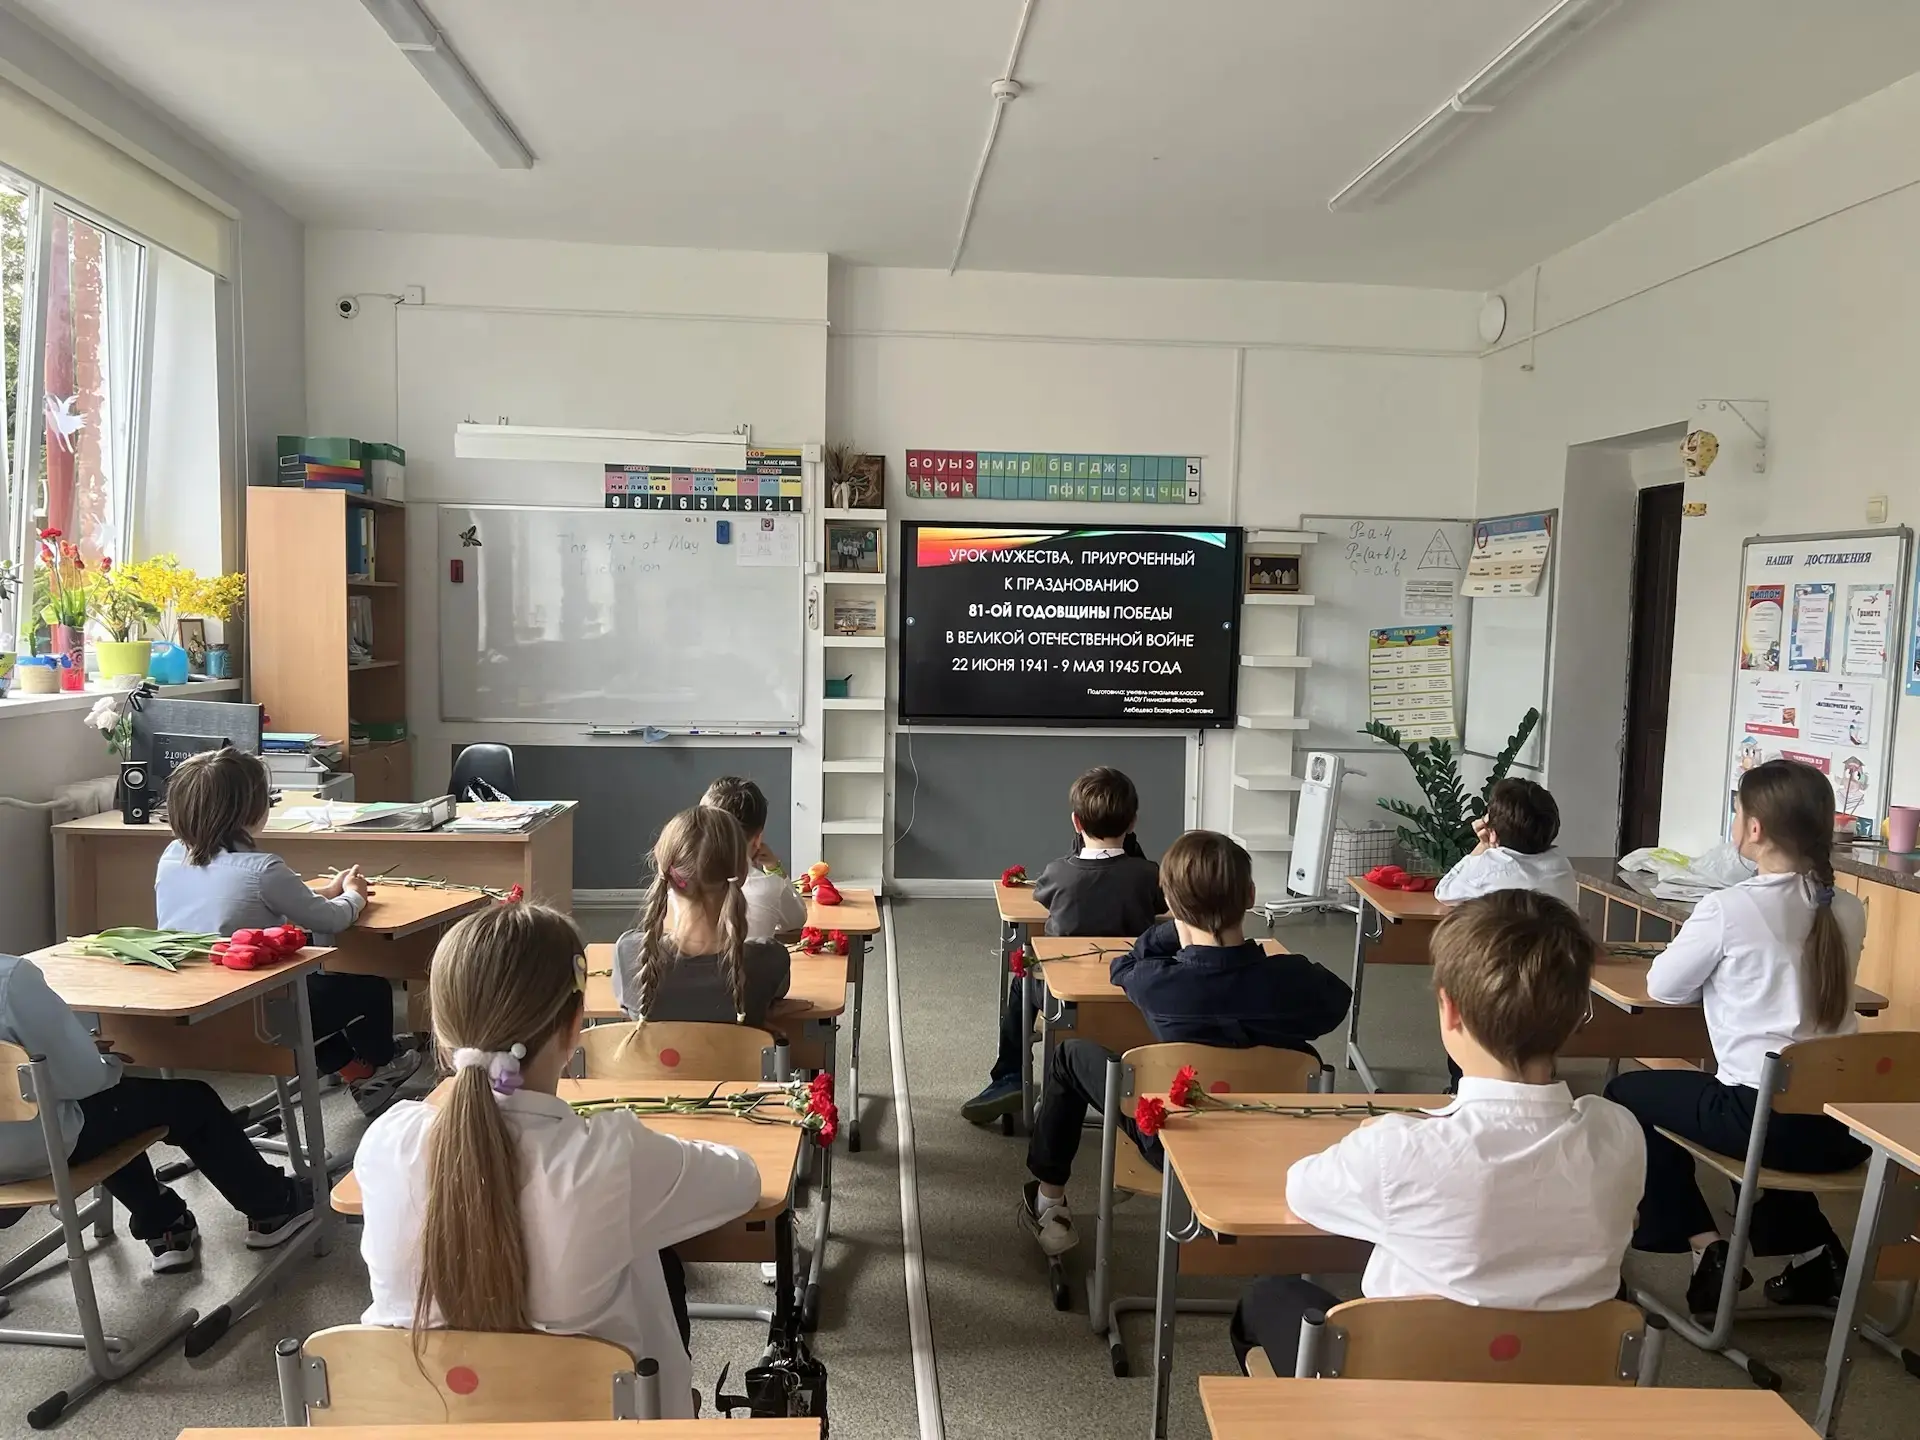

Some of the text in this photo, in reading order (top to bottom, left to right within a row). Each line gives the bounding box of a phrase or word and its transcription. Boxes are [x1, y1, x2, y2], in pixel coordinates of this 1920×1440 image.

[612, 496, 794, 511] 9 8 7 6 5 4 3 2 1
[668, 535, 700, 555] May
[949, 548, 1195, 567] УРОК МУЖЕСТВА, ПРИУРОЧЕННЫЙ
[1765, 552, 1872, 566] НАШИ ДОСТИЖЕНИЯ
[1004, 577, 1139, 593] К ПРАЗДНОВАНИЮ
[1749, 590, 1781, 600] ДИПЛОМ
[968, 602, 1173, 622] 81-ОЙ ГОДОВЩИНЫ ПОБЕДЫ
[1857, 607, 1881, 618] Грамота
[945, 629, 1195, 648] В ВЕЛИКОЙ ОТЕЧЕСТВЕННОЙ ВОЙНЕ
[951, 658, 969, 671] 22
[971, 658, 1015, 672] ИЮНЯ
[1020, 658, 1048, 672] 1941
[1061, 659, 1070, 673] 9
[1073, 659, 1105, 673] МАЯ
[1109, 660, 1140, 674] 1945
[1143, 661, 1183, 675] ГОДА
